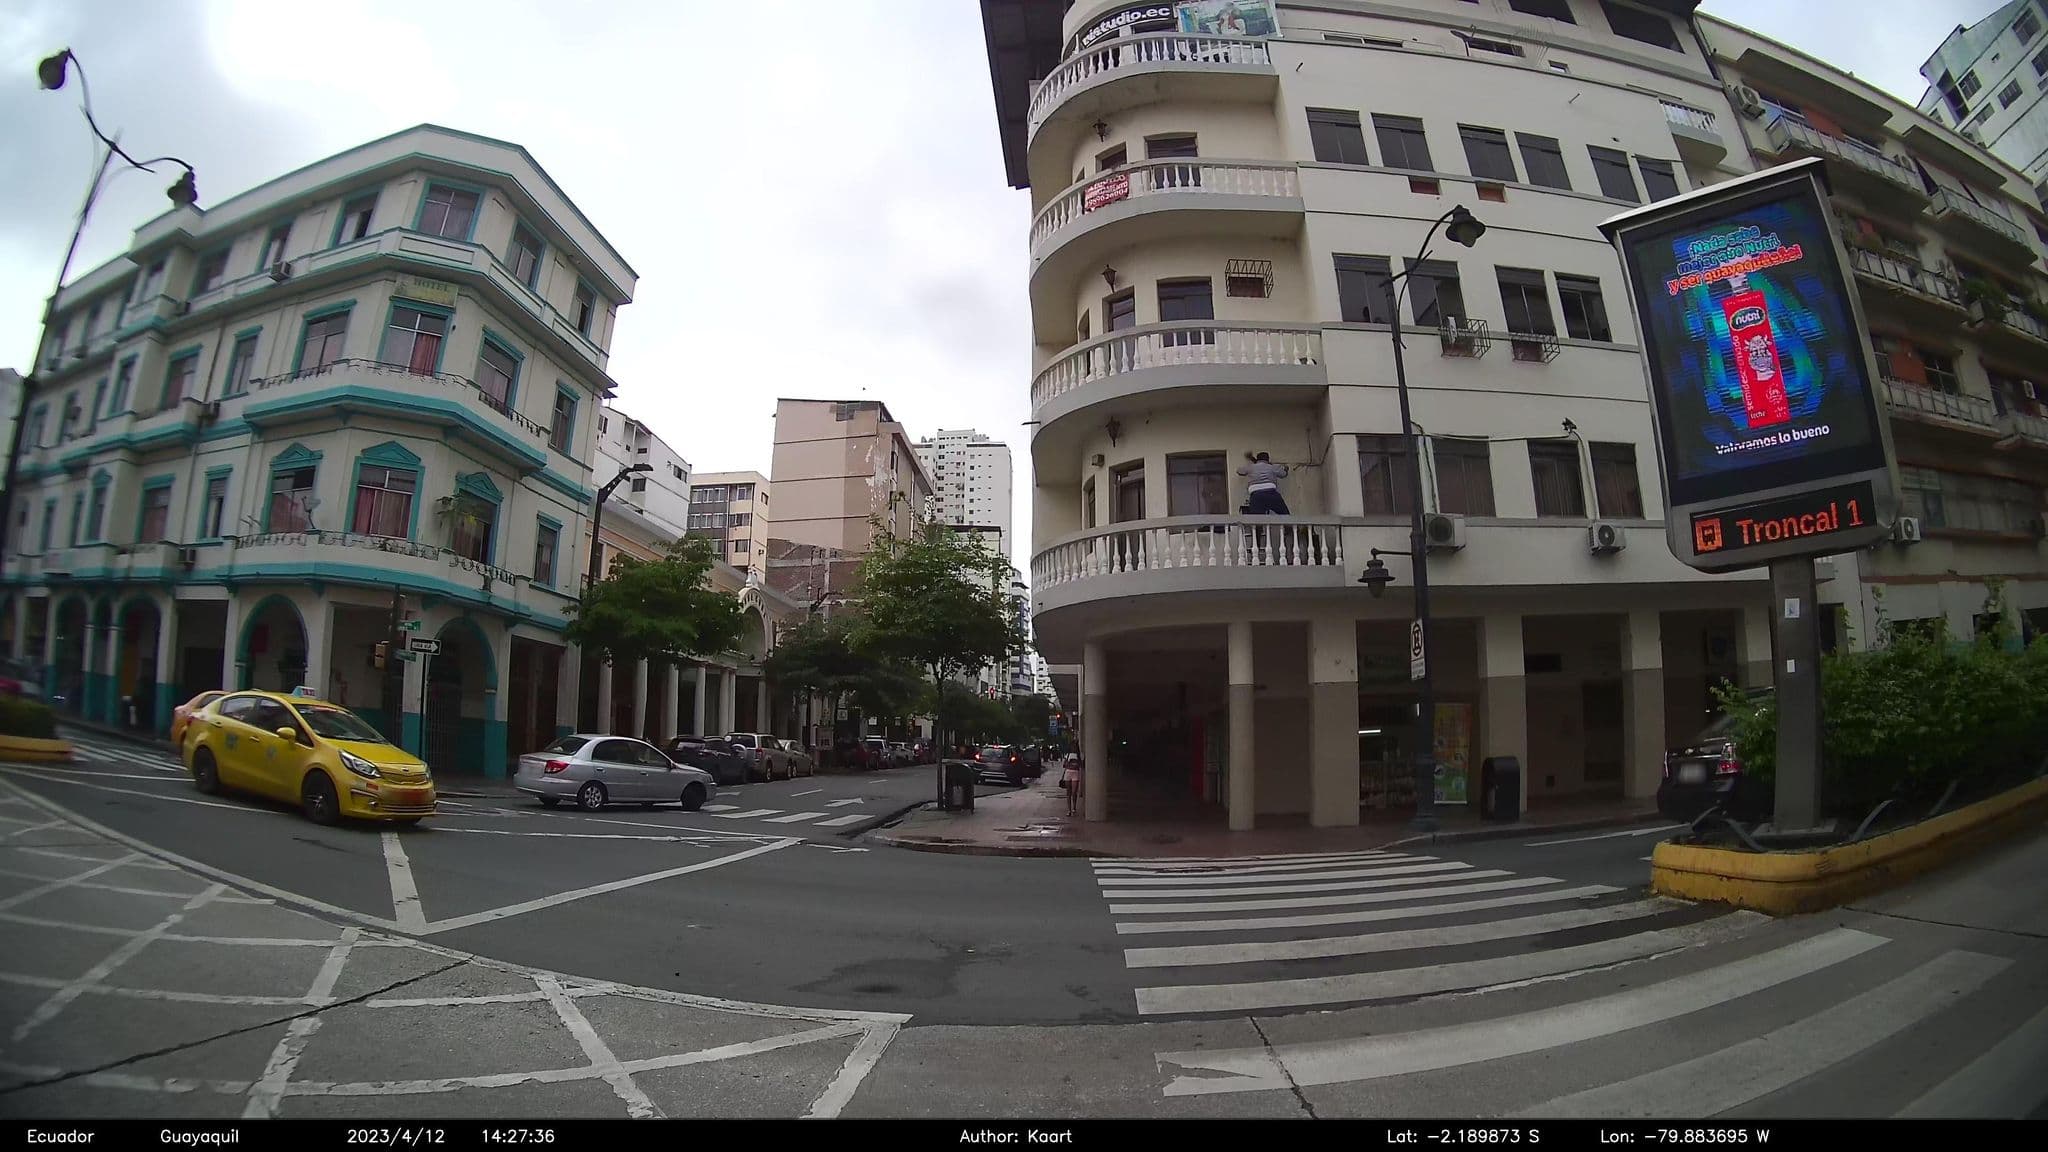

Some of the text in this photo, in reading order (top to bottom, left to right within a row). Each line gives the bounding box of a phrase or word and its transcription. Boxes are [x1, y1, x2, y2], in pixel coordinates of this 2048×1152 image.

[1667, 279, 1679, 295] y
[1680, 273, 1702, 289] ser
[1778, 432, 1792, 444] lo
[1792, 425, 1830, 441] bueno
[1736, 500, 1864, 546] Troncal 1
